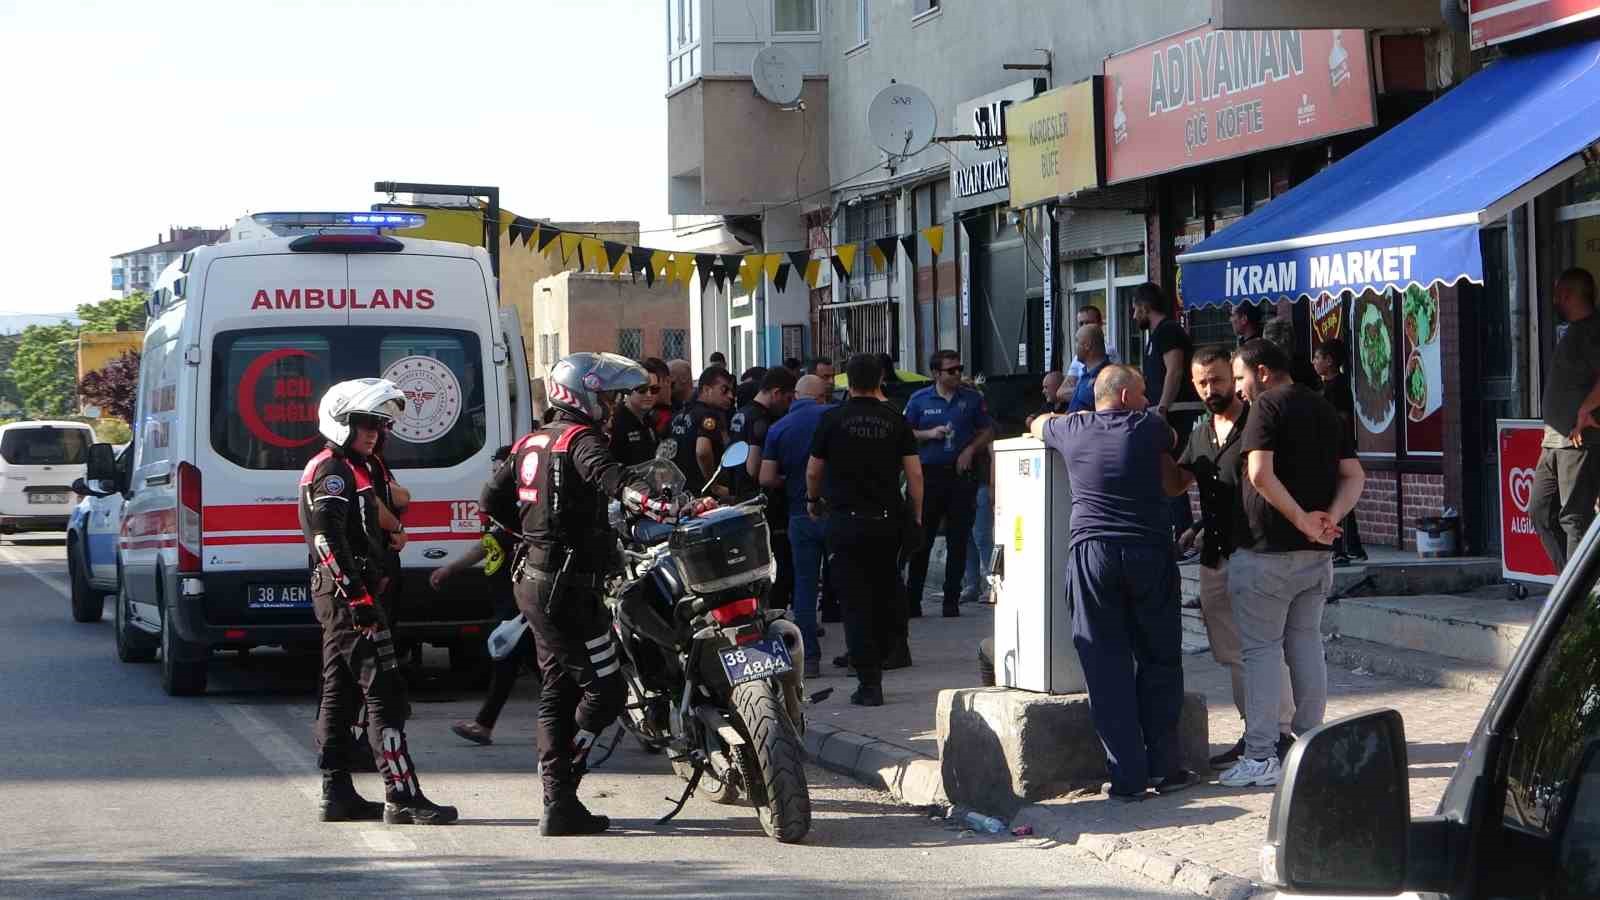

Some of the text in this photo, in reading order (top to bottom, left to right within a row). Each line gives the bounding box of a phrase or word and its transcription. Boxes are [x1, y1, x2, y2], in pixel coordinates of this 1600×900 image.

[1149, 29, 1304, 116] ADIYAMAN
[1215, 98, 1265, 141] KÖFTE
[1225, 246, 1417, 297] İKRAM MARKET
[251, 288, 435, 310] AMBULANS
[450, 502, 480, 520] 112
[258, 587, 307, 602] 38 AEN
[724, 650, 747, 666] 38
[743, 656, 786, 676] 4844
